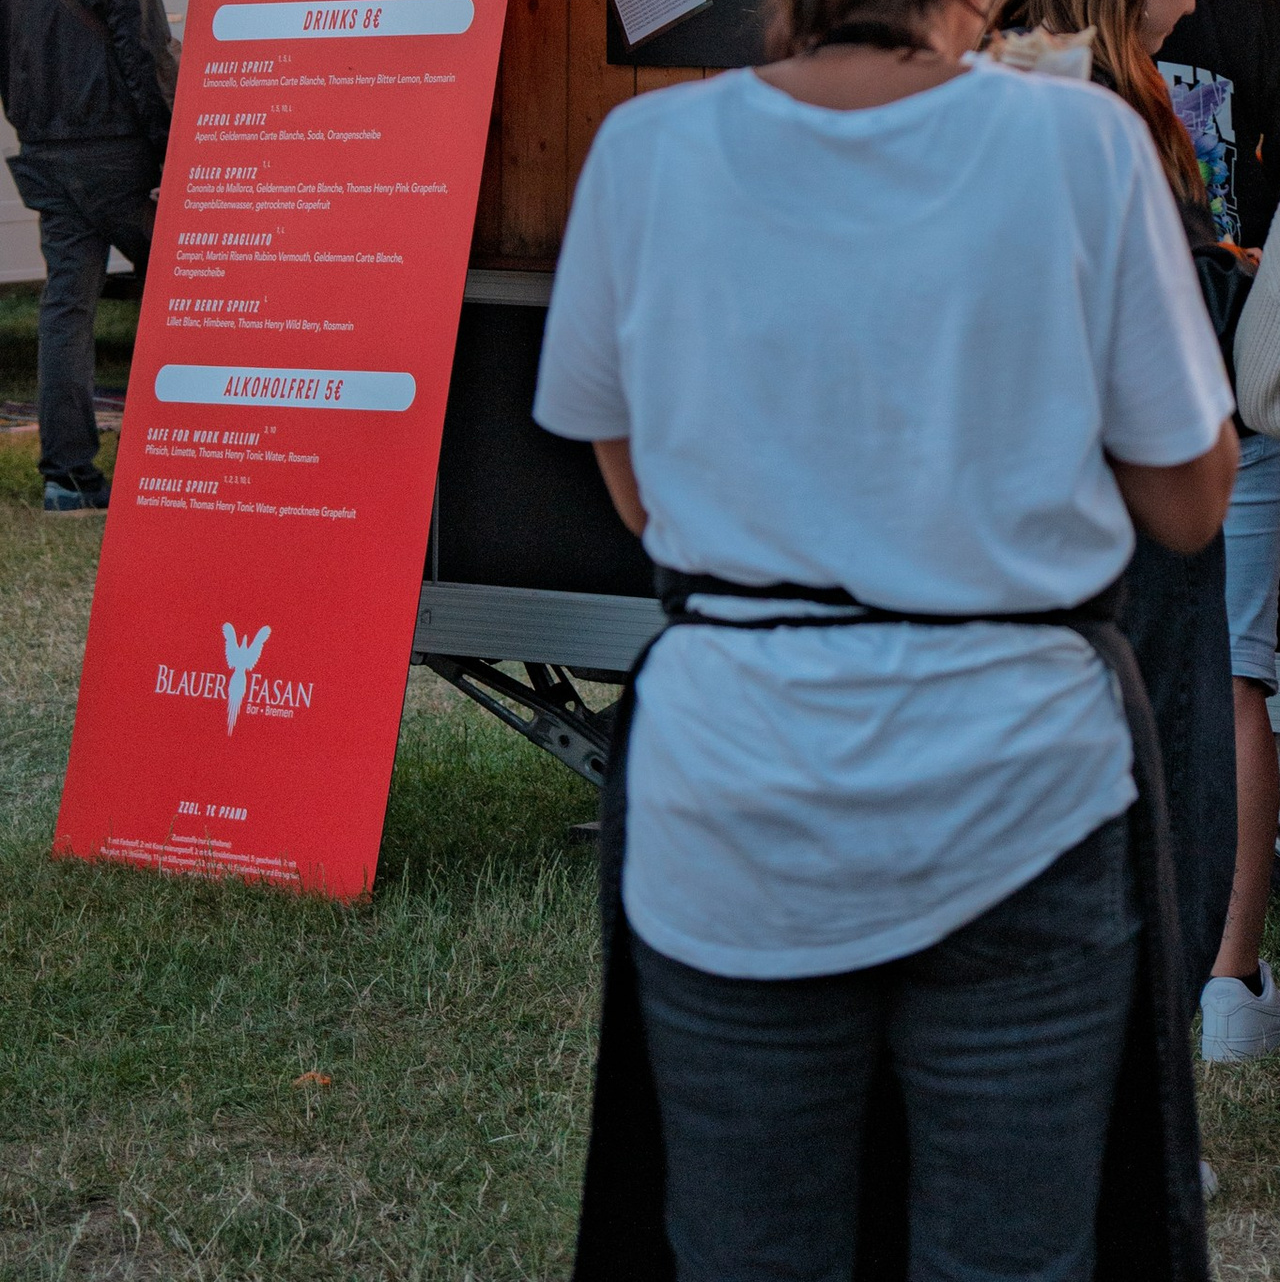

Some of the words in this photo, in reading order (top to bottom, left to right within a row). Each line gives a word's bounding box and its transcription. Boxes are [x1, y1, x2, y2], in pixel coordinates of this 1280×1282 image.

[303, 9, 358, 30] DRINKS
[363, 8, 382, 29] 8€
[205, 62, 238, 74] AMALFI
[242, 61, 274, 73] SPRITZ
[197, 114, 230, 125] APEROL
[234, 113, 266, 125] SPRITZ
[225, 167, 257, 179] SPRITZ
[178, 233, 218, 245] NEGRONI
[169, 299, 191, 310] VERY
[195, 300, 224, 311] BERRY
[227, 300, 260, 312] SPRITZ
[224, 376, 320, 399] ALKOHOLFREI
[325, 380, 343, 400] 5€
[147, 428, 168, 440] SAFE
[172, 429, 189, 441] FOR
[193, 430, 219, 443] WORK
[222, 432, 259, 445] BELLINI
[139, 478, 182, 492] FLOREALE
[186, 480, 218, 494] SPRITZ
[155, 664, 227, 700] BLAUER
[248, 674, 314, 708] FASAN
[219, 805, 247, 820] PFAND
